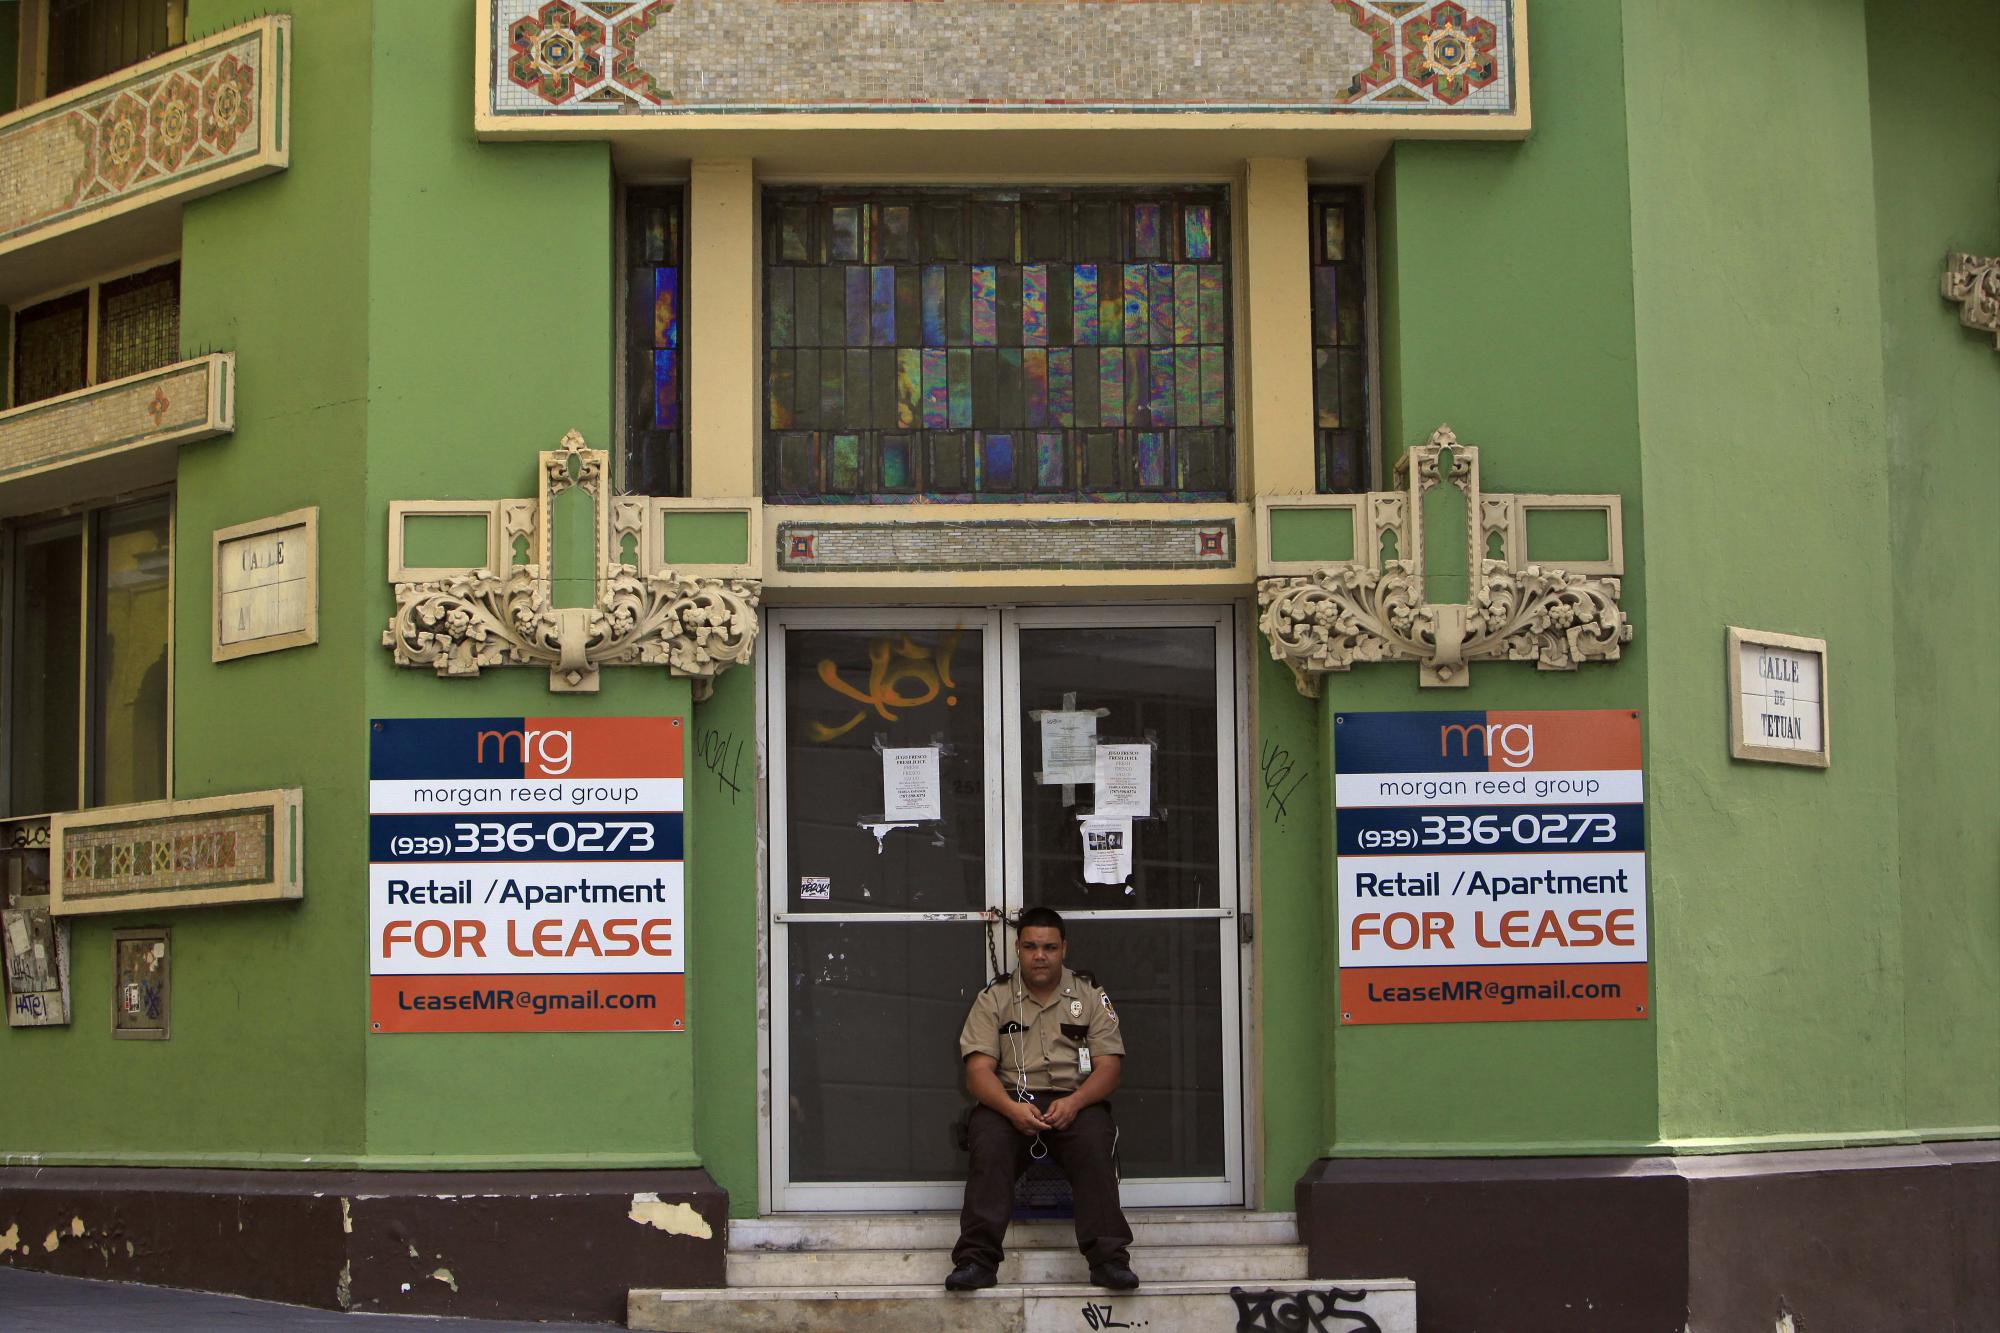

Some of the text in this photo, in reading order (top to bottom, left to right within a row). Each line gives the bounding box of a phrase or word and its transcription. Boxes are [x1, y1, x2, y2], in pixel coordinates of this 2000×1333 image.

[1758, 655, 1799, 683] CALLE
[1773, 689, 1786, 706] DE
[1760, 713, 1802, 740] TETUAN
[477, 729, 573, 775] mrg
[1441, 723, 1535, 768] mrg
[414, 784, 639, 806] morgan reed group
[1379, 777, 1600, 799] morgan reed group
[390, 821, 655, 856] (939) 336-0273
[1357, 813, 1617, 849] (939) 336-0273
[387, 879, 472, 904] Retail
[1355, 871, 1440, 897] Retail
[382, 918, 673, 958] FOR LEASE
[1351, 908, 1635, 950] FOR LEASE
[398, 990, 657, 1015] LeaseMR@gmail.com
[1367, 979, 1621, 1005] LeaseMR@gmail.com
